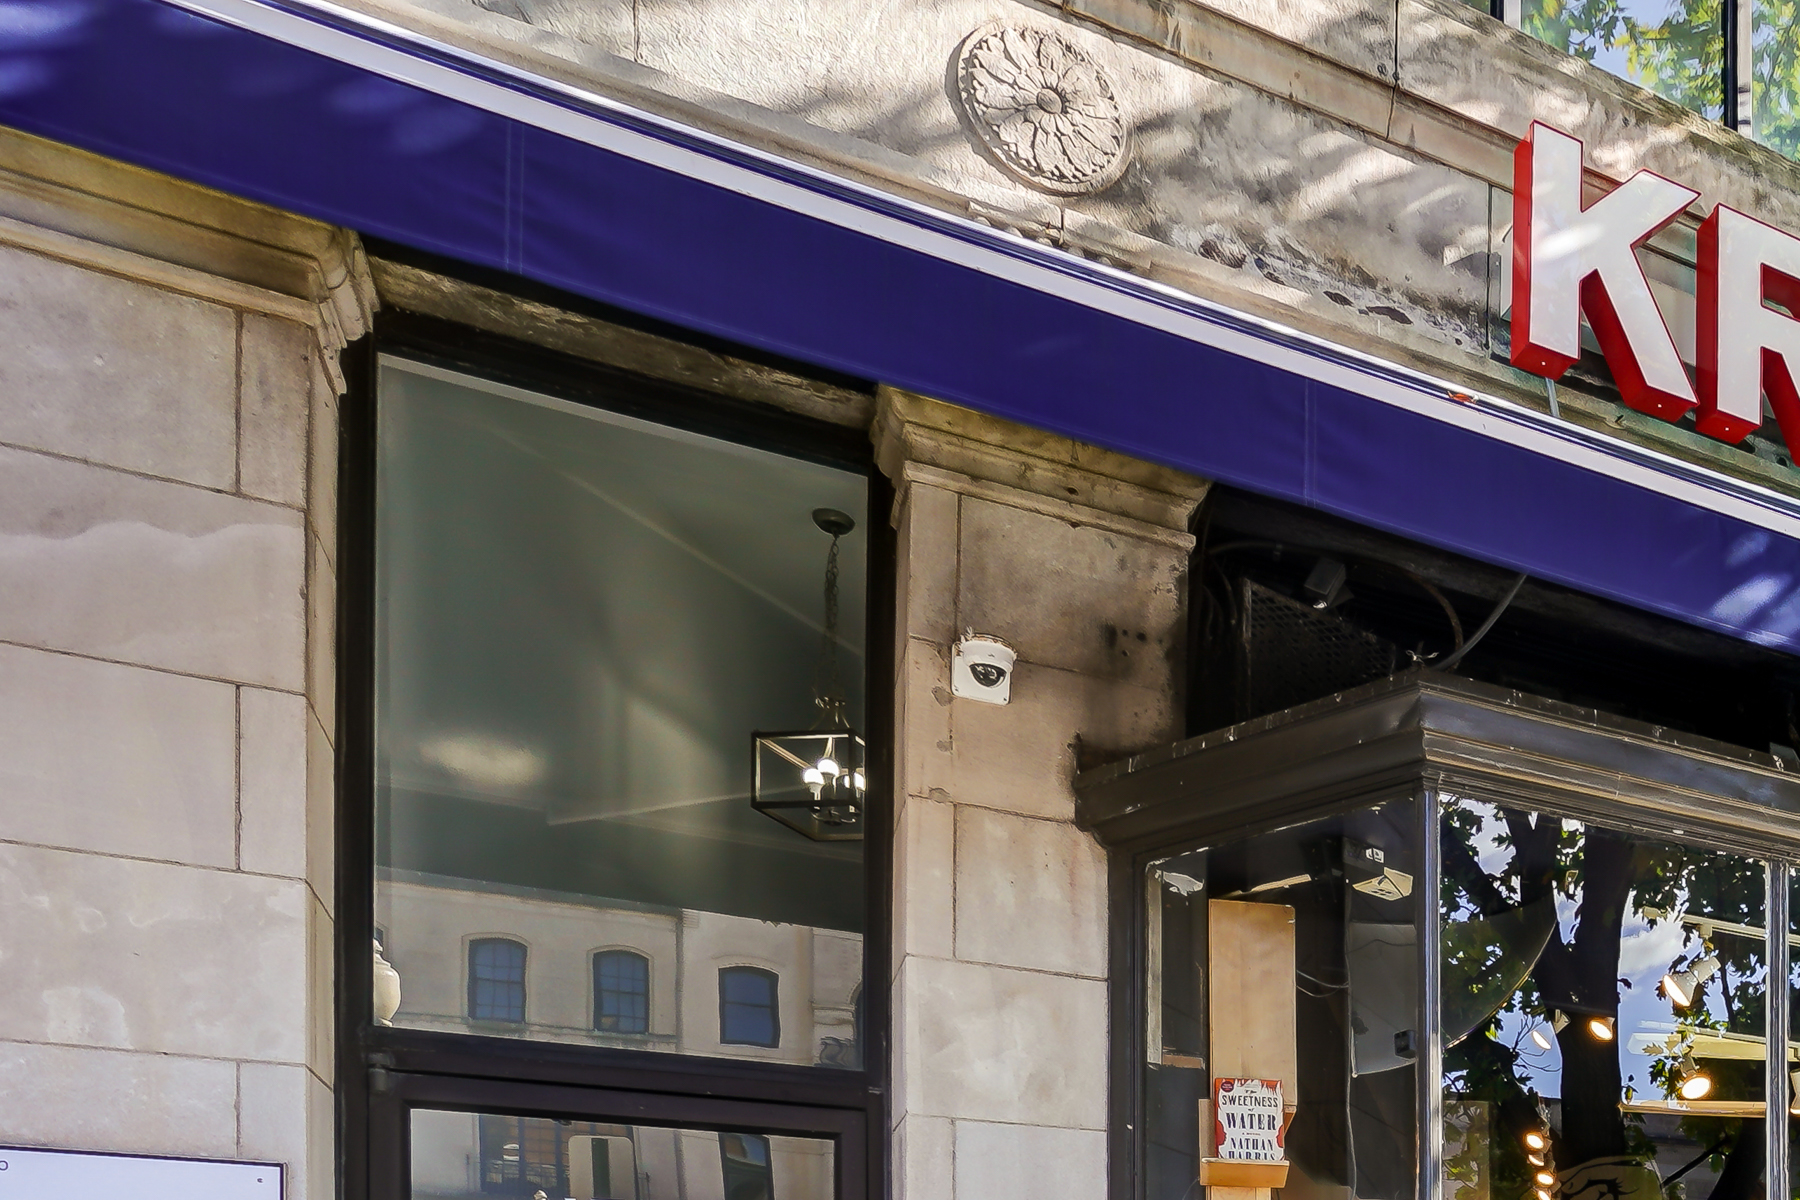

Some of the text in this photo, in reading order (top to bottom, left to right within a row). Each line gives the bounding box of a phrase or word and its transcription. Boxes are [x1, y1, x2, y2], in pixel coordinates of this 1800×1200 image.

[1222, 1094, 1278, 1108] SWEETNESS
[1226, 1112, 1277, 1131] WATER
[1230, 1137, 1274, 1151] NATHAN
